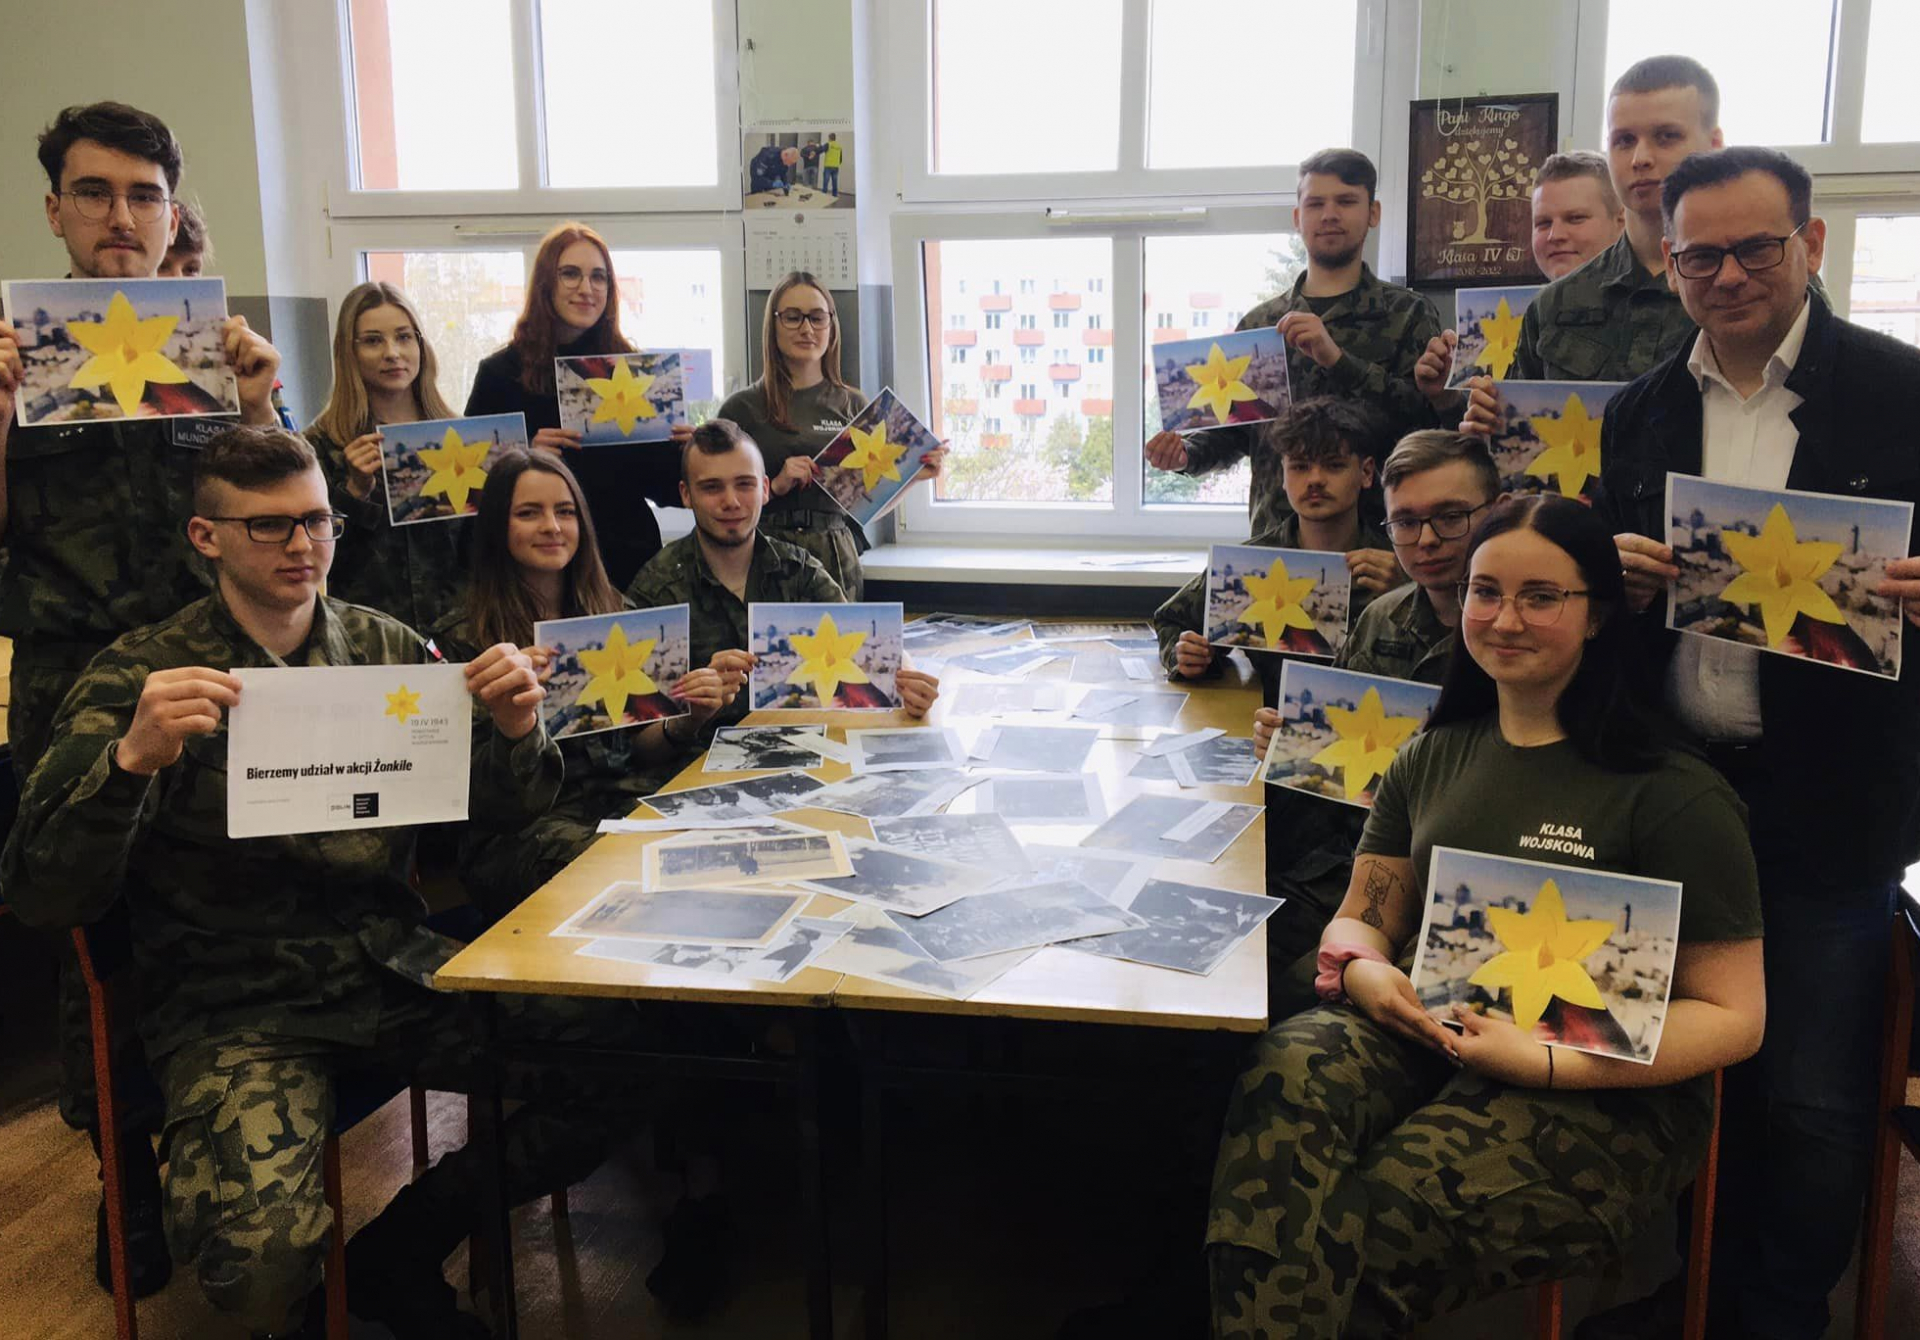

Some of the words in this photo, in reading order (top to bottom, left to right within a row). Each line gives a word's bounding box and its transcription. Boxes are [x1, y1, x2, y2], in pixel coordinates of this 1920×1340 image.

[1437, 248, 1477, 265] Klasa
[1483, 248, 1502, 262] IV
[246, 767, 298, 780] Bierzemy
[300, 763, 334, 777] udział
[335, 765, 345, 775] w
[346, 761, 372, 776] akcji
[373, 758, 413, 773] Żonkile
[1539, 823, 1582, 840] KLASA
[1519, 835, 1595, 860] WOJSKOWA
